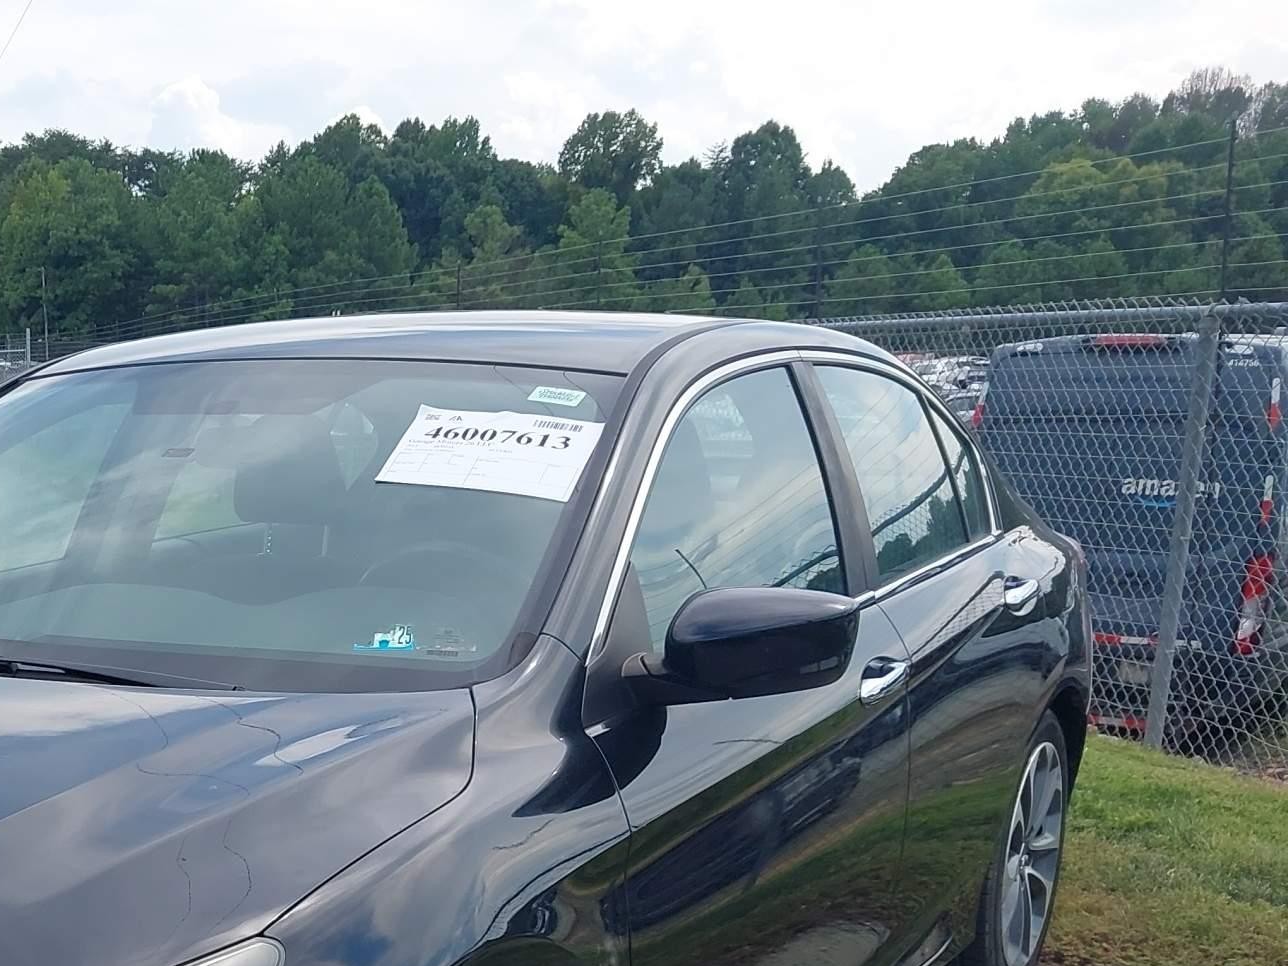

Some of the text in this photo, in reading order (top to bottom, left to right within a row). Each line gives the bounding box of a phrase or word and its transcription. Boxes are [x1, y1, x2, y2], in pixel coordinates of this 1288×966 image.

[424, 425, 572, 451] 46007613
[1121, 477, 1221, 499] amaon
[397, 626, 412, 645] 25
